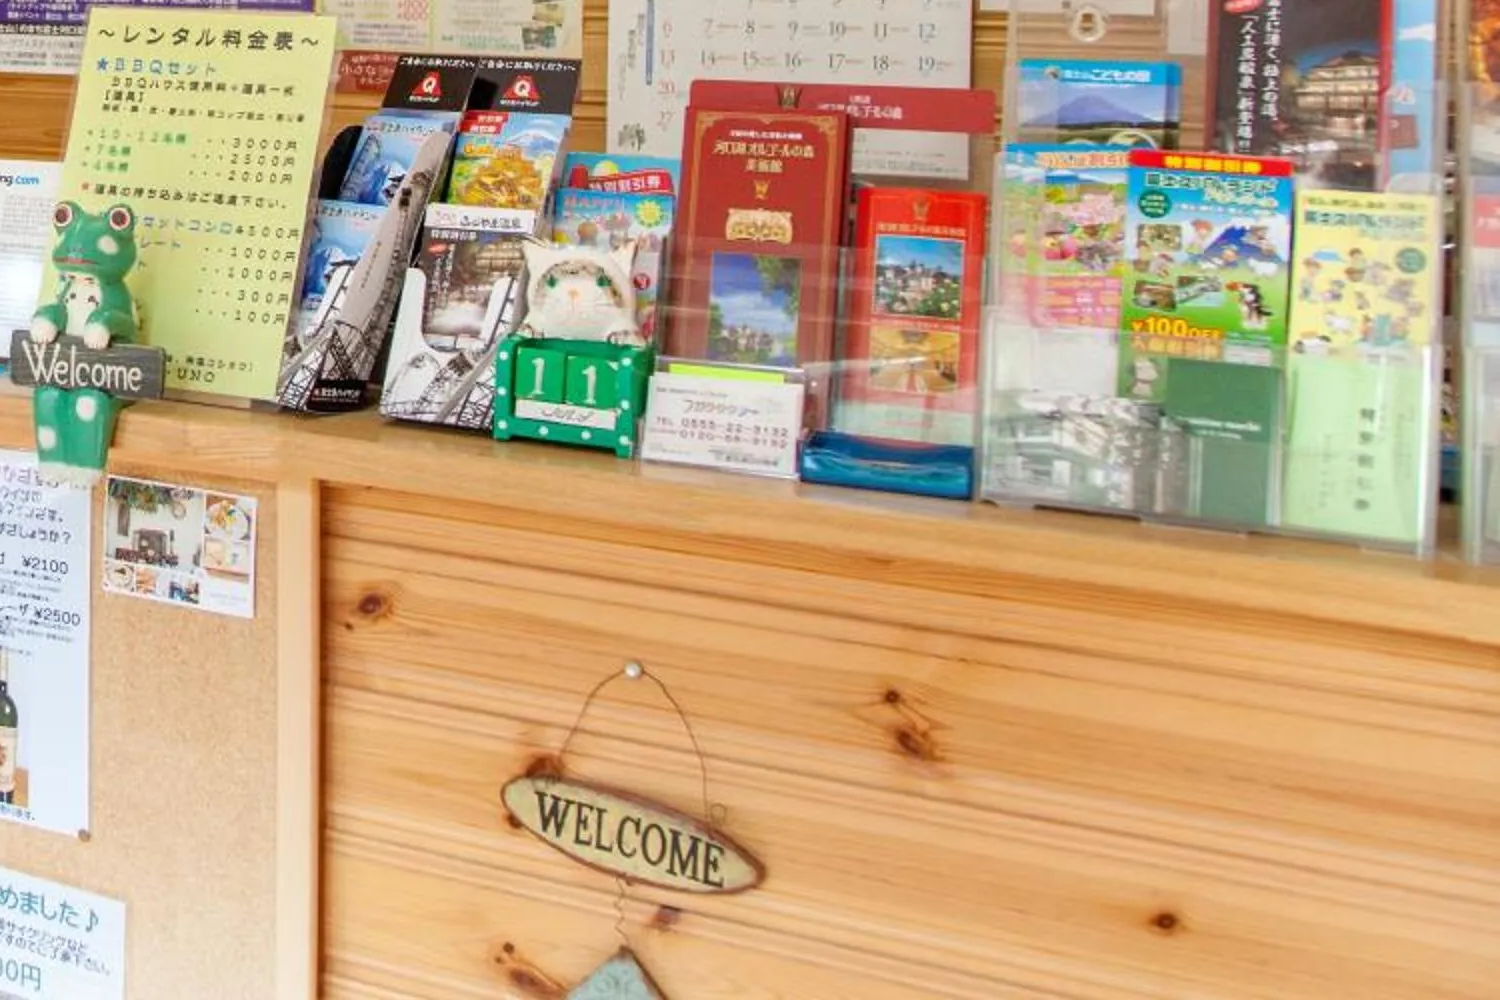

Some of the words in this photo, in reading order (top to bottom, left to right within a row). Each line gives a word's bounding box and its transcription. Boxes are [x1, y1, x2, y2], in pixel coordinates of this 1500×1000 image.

[745, 19, 755, 35] 8
[787, 21, 799, 38] 9
[828, 21, 847, 38] 10
[872, 21, 889, 39] 11
[917, 21, 936, 40] 12
[700, 50, 717, 68] 14
[742, 51, 759, 68] 15
[784, 51, 801, 69] 16
[827, 53, 847, 70] 17
[871, 53, 890, 71] 18
[916, 53, 937, 72] 19
[512, 77, 531, 97] Q
[21, 338, 142, 393] Welcome
[177, 366, 216, 383] UNO
[531, 356, 545, 396] 1
[581, 364, 597, 405] 1
[21, 554, 69, 576] ¥2100
[34, 606, 82, 628] ¥2500
[534, 789, 726, 889] WELCOME
